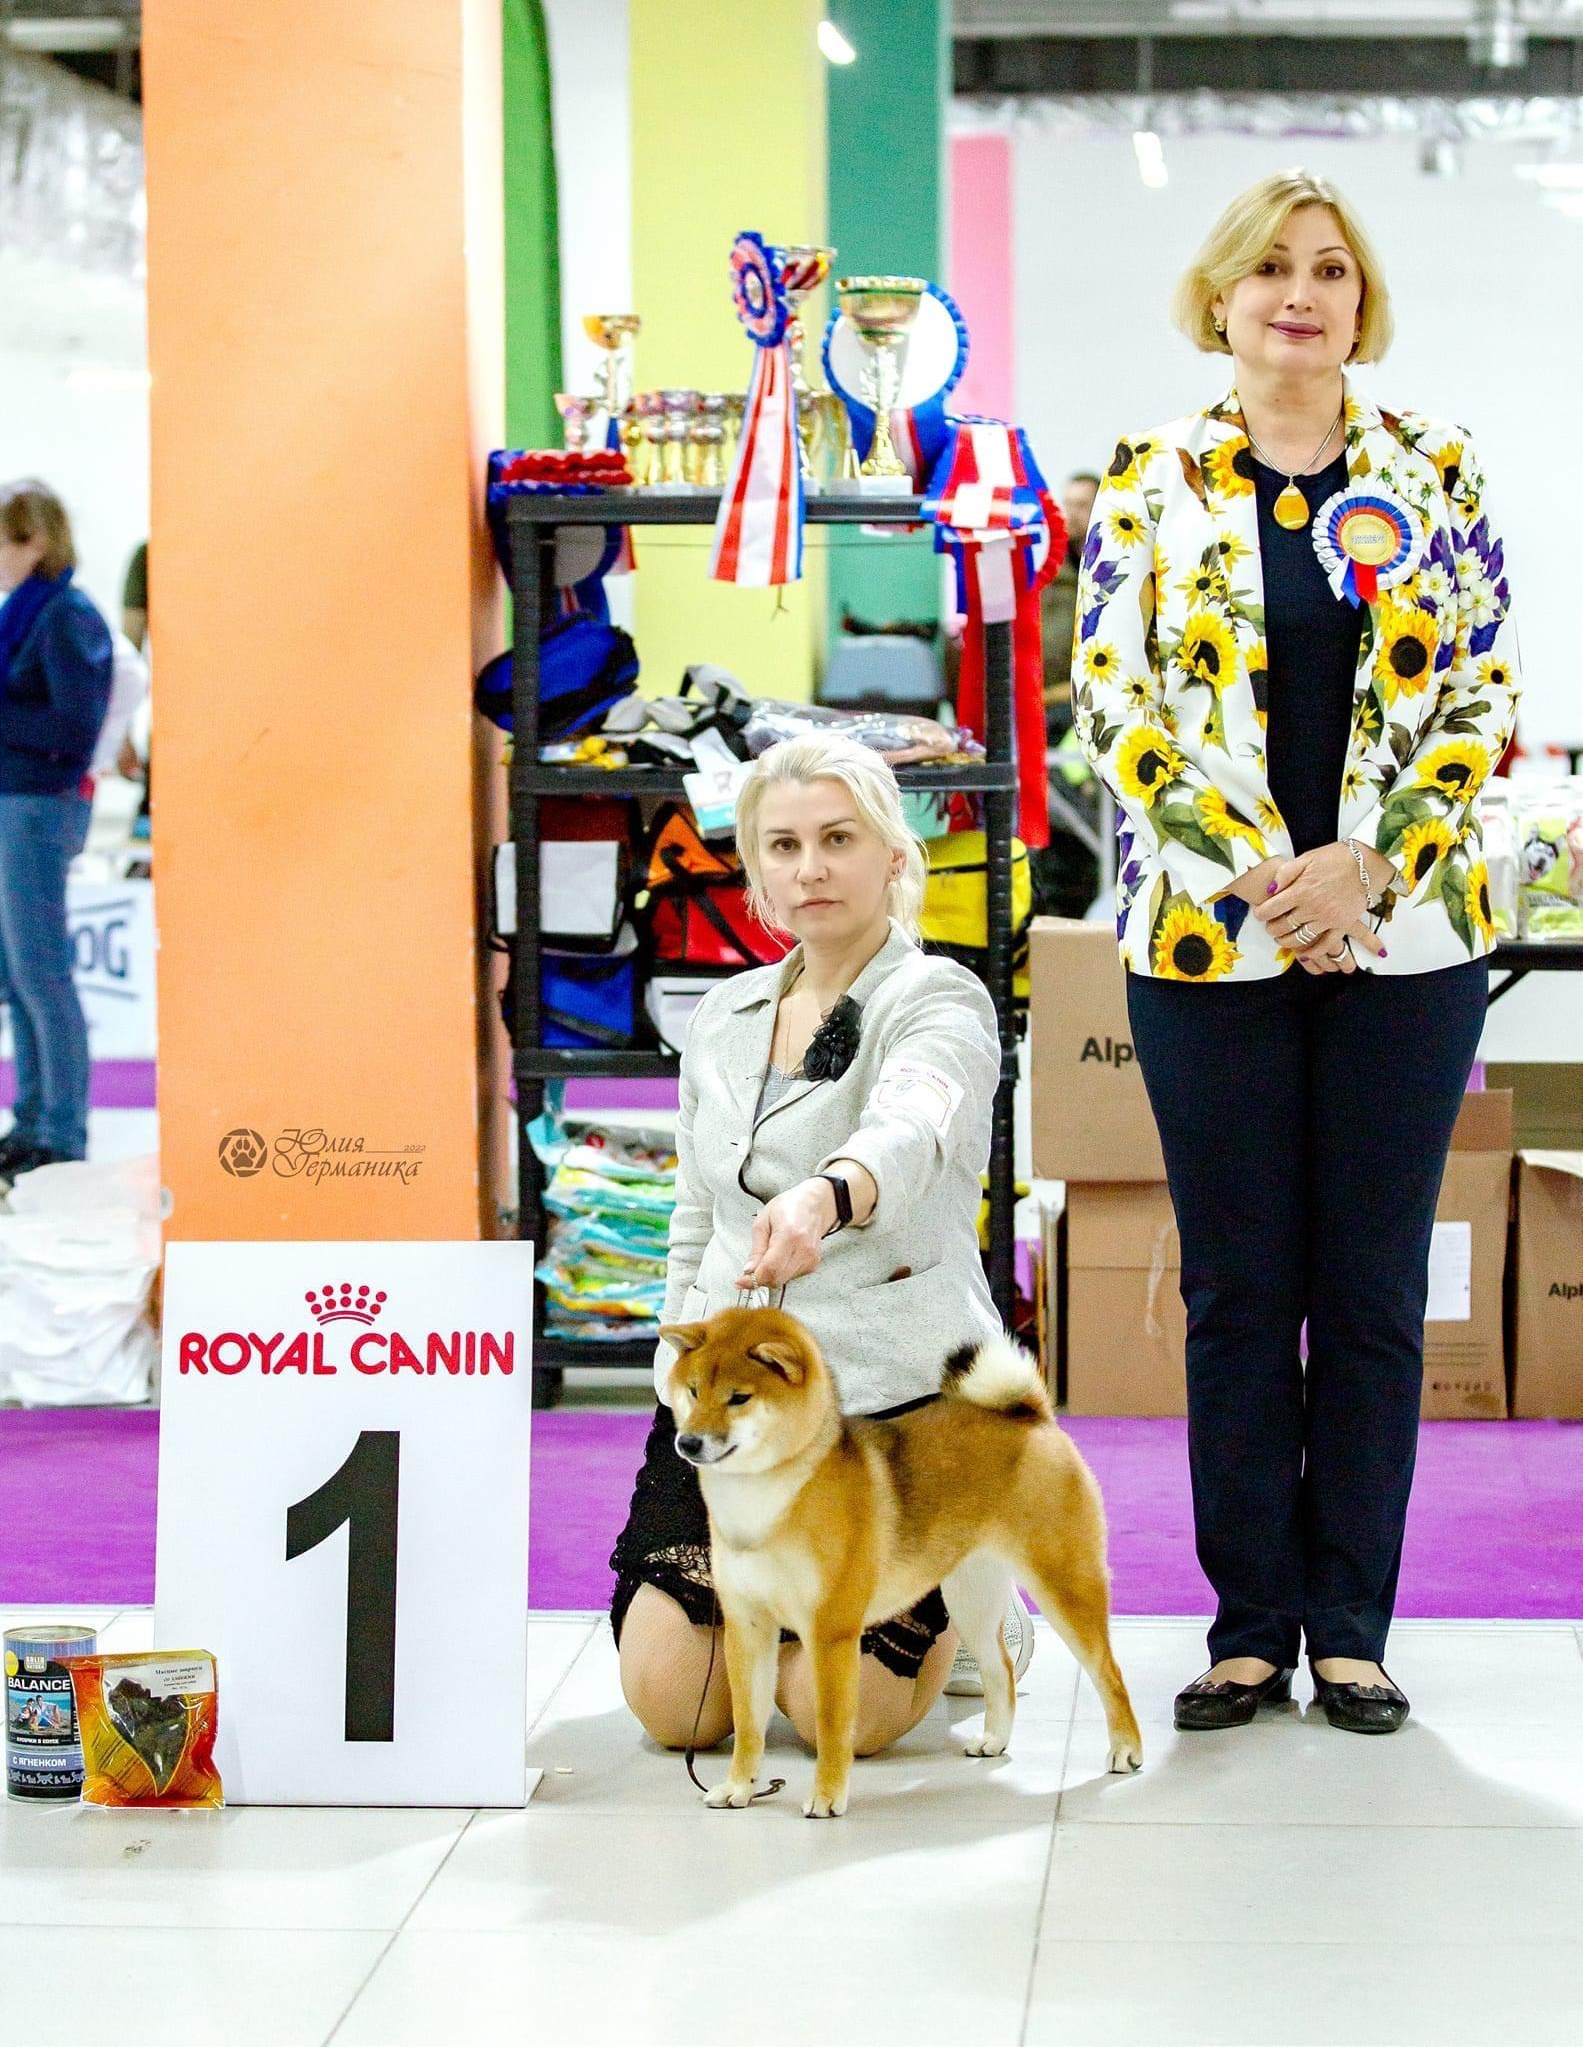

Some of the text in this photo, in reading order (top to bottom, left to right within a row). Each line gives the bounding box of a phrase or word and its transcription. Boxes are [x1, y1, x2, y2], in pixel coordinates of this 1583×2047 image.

[75, 919, 129, 978] OG
[1080, 1037, 1138, 1068] Alp
[179, 1331, 514, 1376] ROYAL CANIN
[286, 1430, 400, 1742] 1
[8, 1677, 71, 1691] BALANCE
[12, 1756, 67, 1767] С ЯГНЕНКОМ
